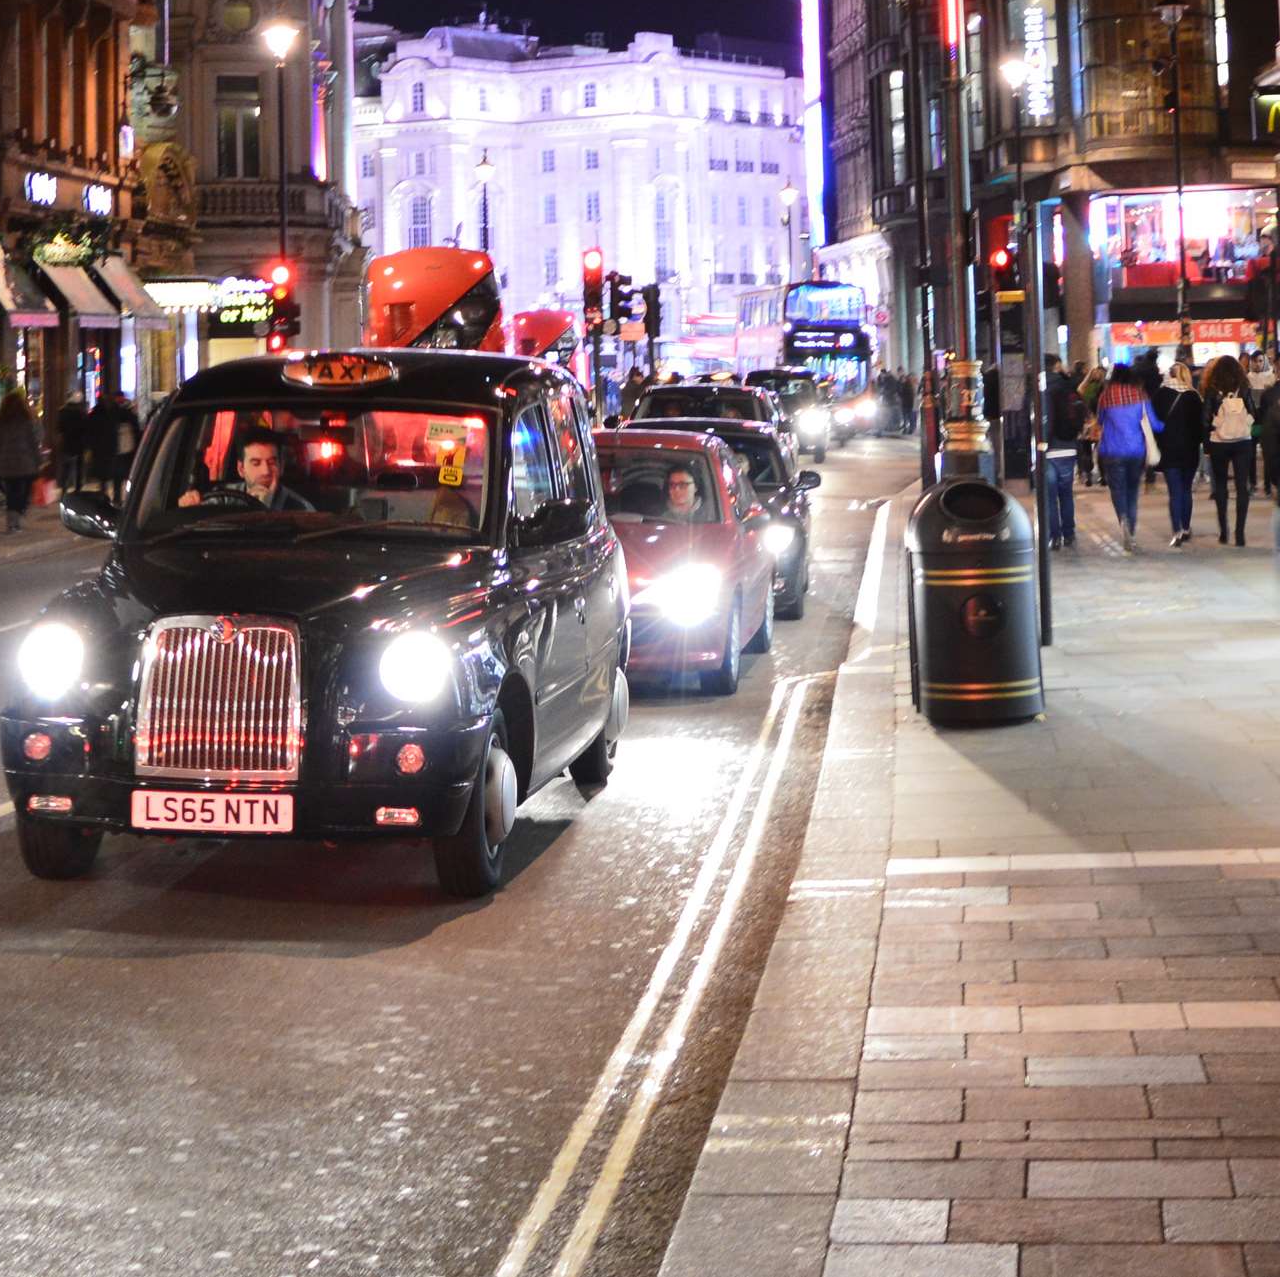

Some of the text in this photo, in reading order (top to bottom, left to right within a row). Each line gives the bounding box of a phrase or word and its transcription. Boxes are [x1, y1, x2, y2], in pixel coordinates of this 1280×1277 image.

[1199, 324, 1233, 339] SALE
[304, 356, 369, 381] TAXI
[145, 796, 279, 825] LS65 NTN
